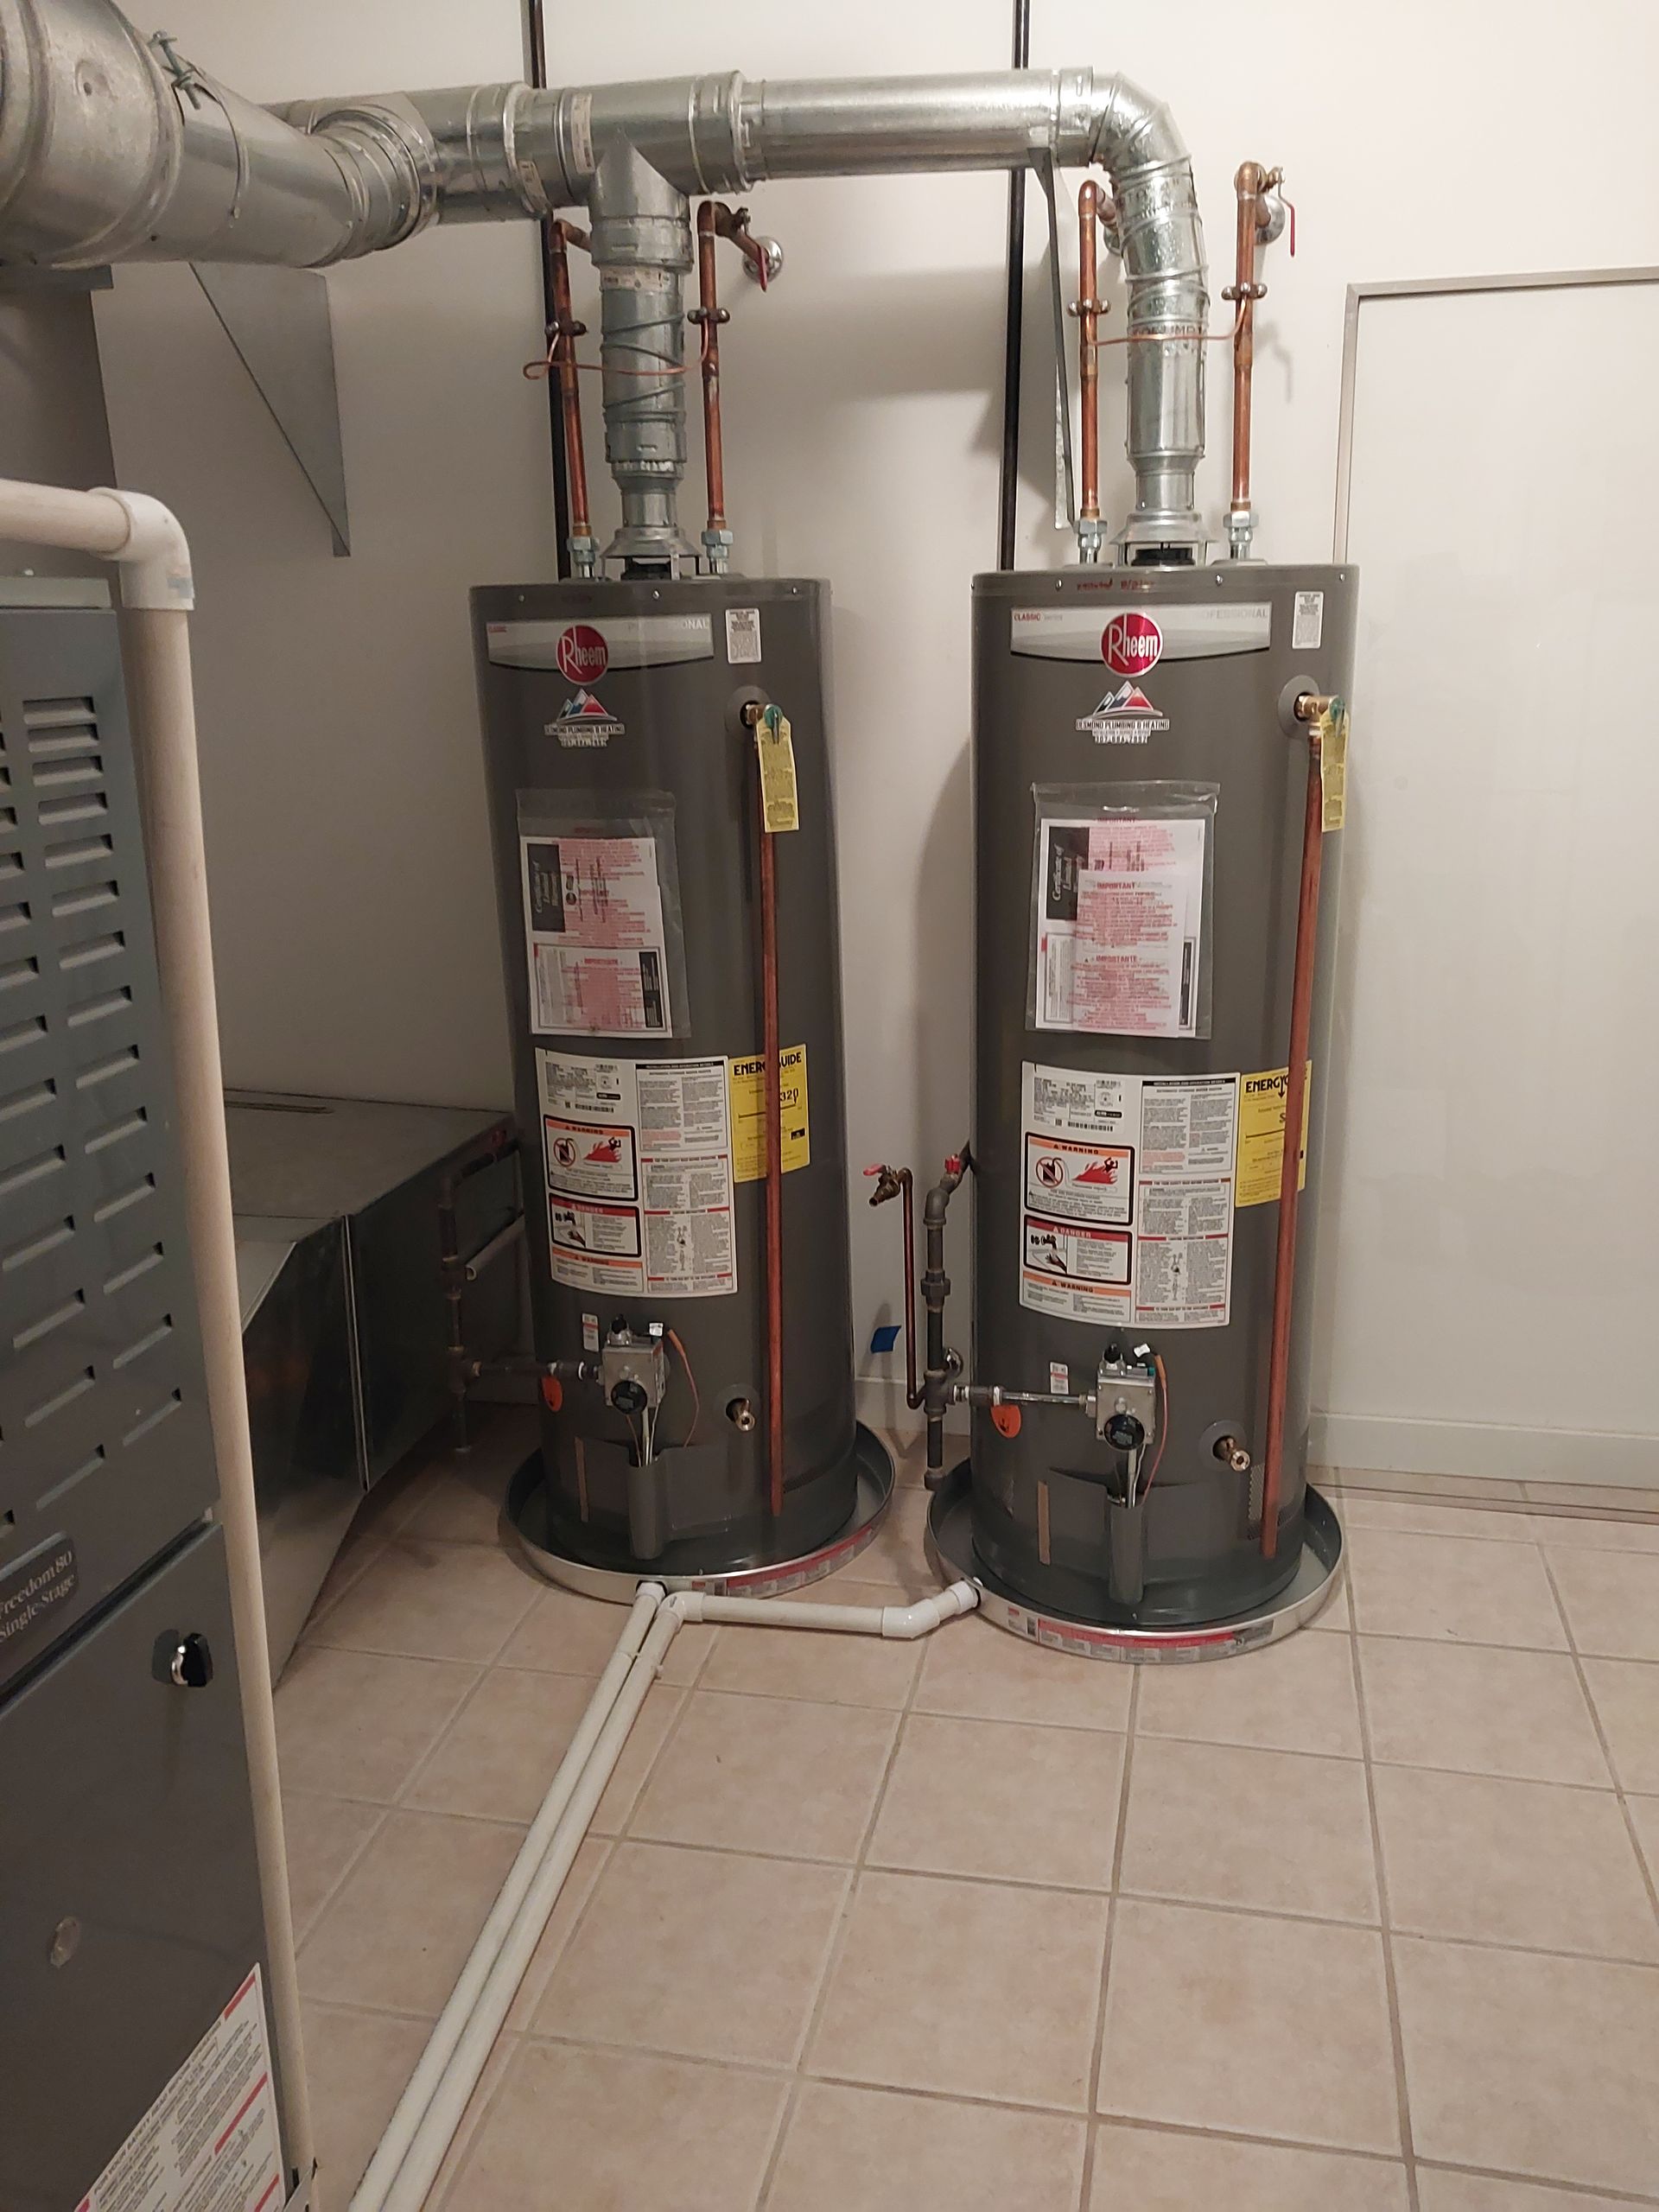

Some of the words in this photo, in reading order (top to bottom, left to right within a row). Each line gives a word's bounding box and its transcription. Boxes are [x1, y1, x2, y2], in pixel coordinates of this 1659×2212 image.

[561, 624, 607, 676] Rheem
[1107, 612, 1159, 667] Rheem
[1096, 881, 1136, 890] IMPORTANT
[1062, 1145, 1099, 1155] WARNING
[1060, 1226, 1091, 1238] DANGER
[1060, 1281, 1094, 1294] WARNING
[0, 1566, 55, 1618] reedom
[55, 1550, 73, 1573] 80
[41, 1573, 75, 1603] Stage
